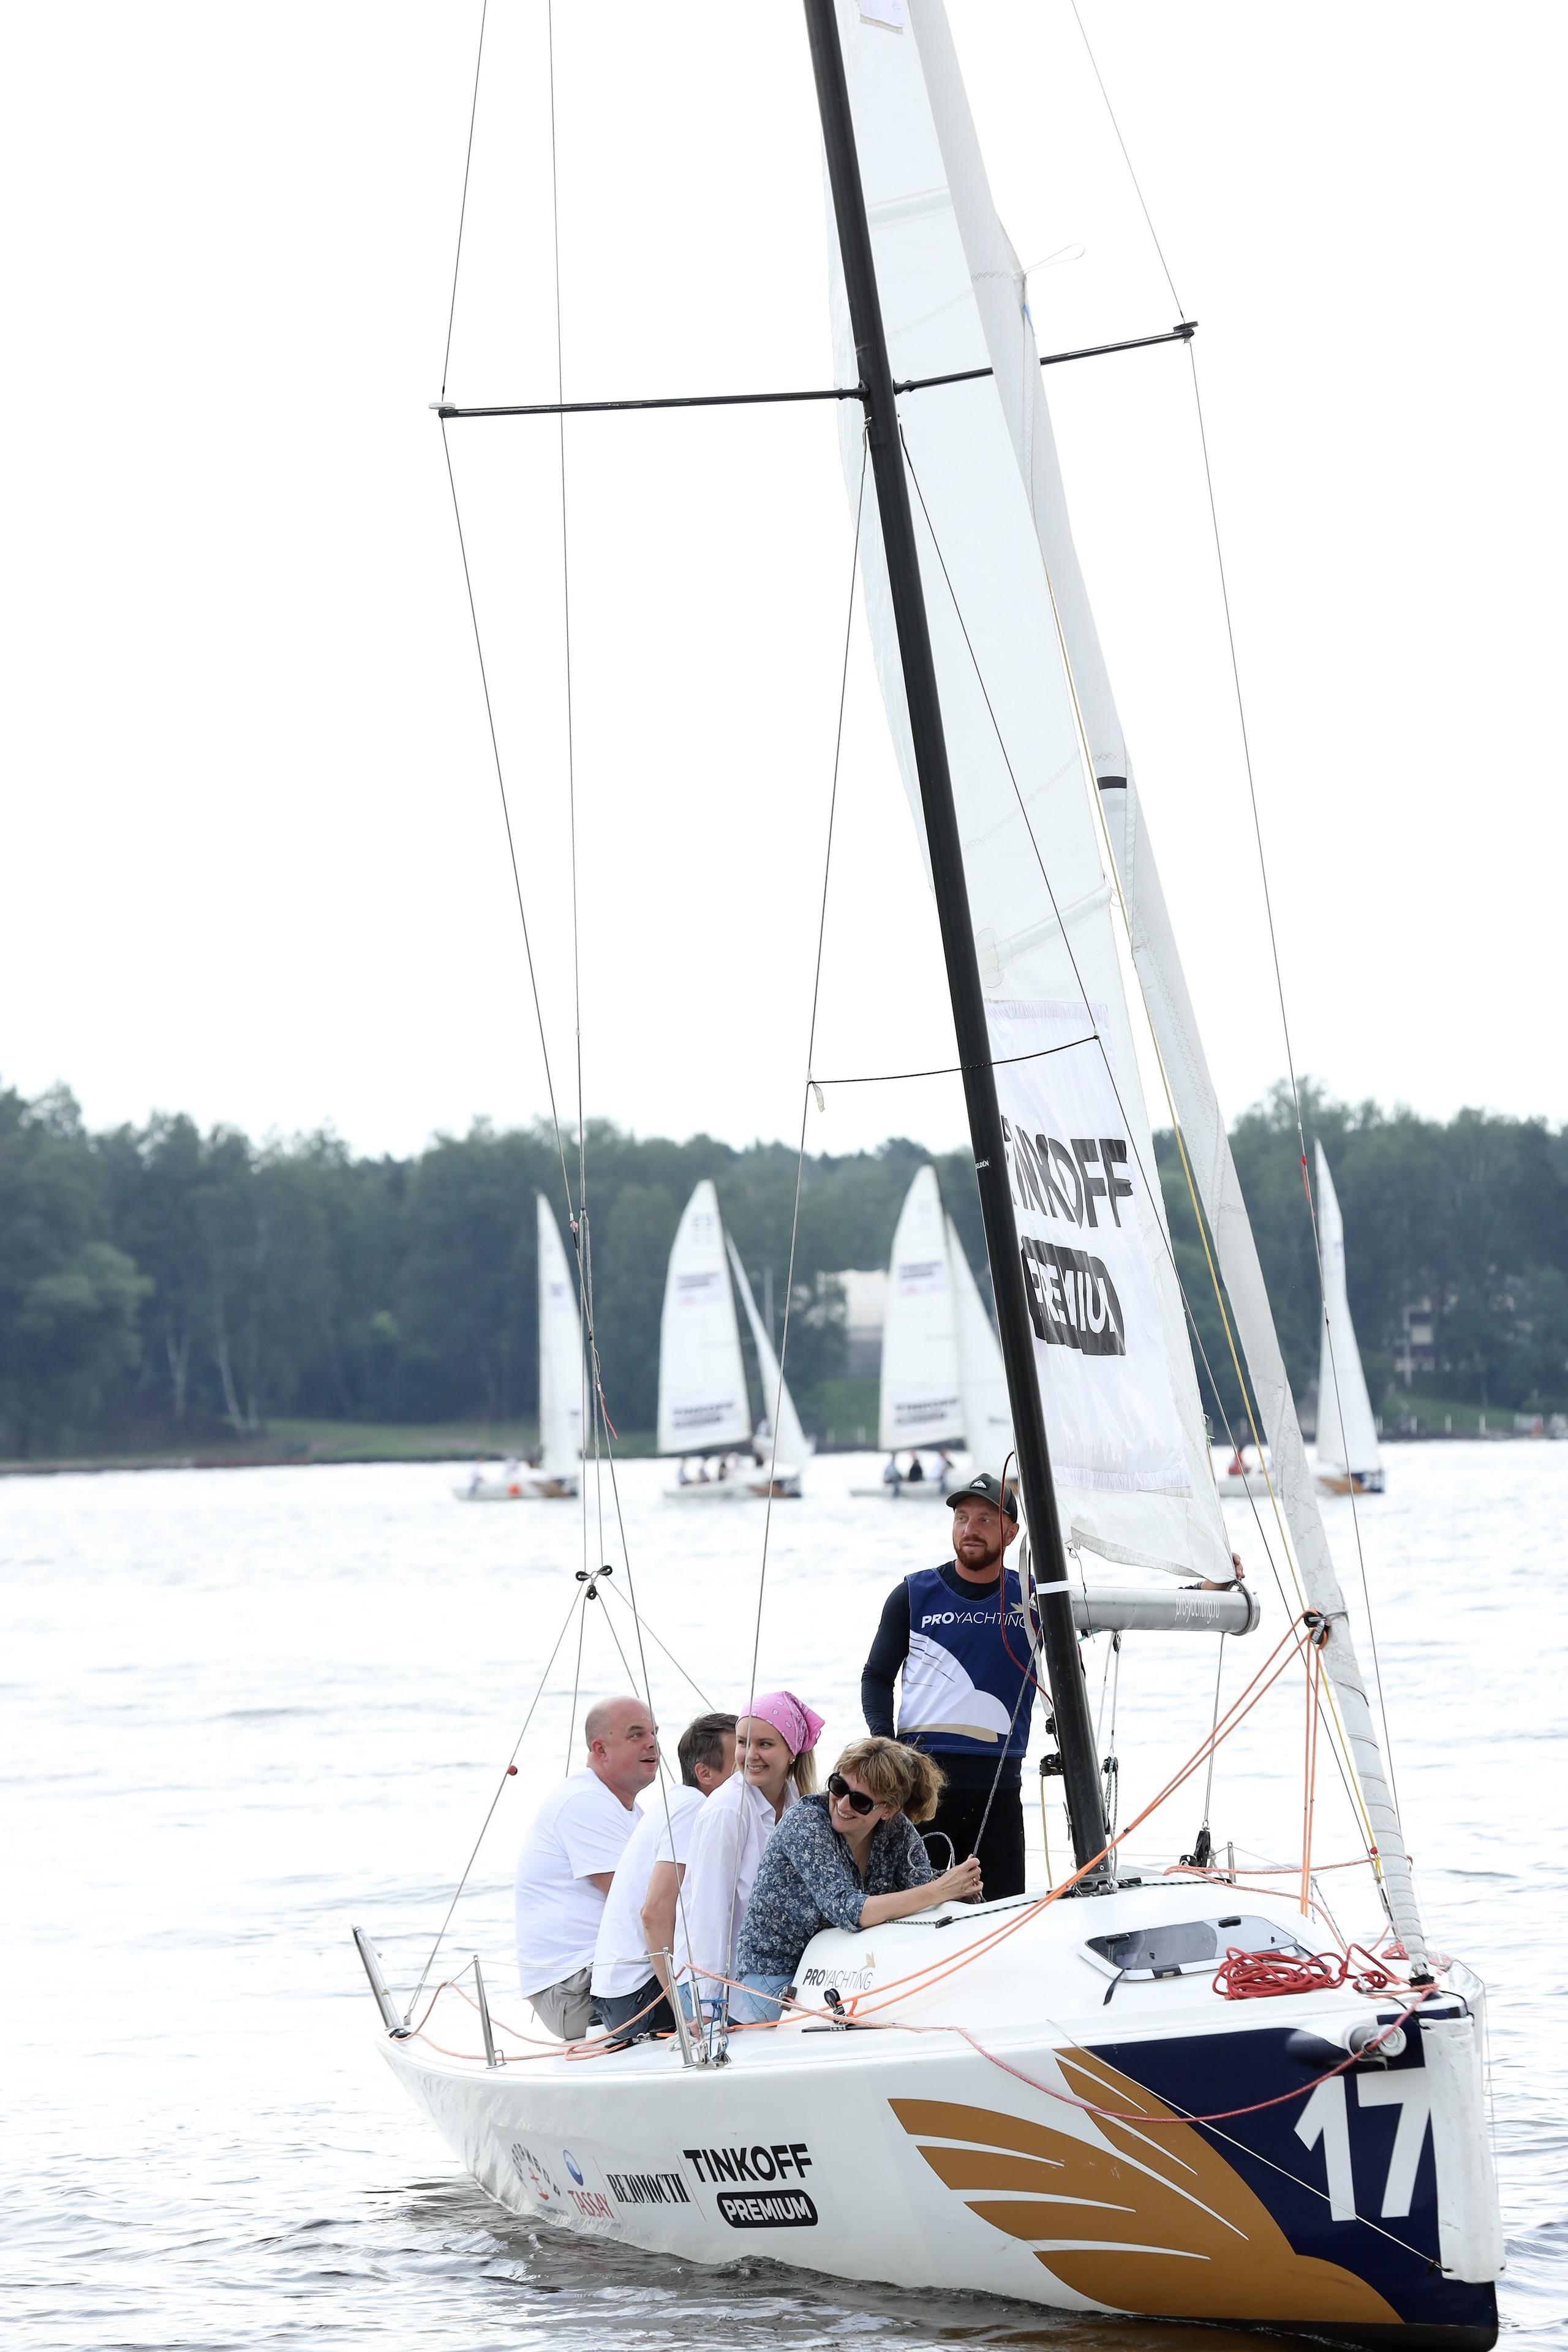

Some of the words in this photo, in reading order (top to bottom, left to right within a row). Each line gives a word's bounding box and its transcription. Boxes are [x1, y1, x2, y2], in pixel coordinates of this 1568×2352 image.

[1174, 1594, 1220, 1625] pro-yachting.ru
[802, 1968, 873, 1990] PROYACHTING
[1293, 2067, 1430, 2222] 17
[682, 2143, 813, 2182] TINKOFF
[567, 2189, 615, 2219] TASSAY
[605, 2173, 692, 2207] ВЕДОМОСТИ
[721, 2196, 813, 2221] PREMIUM
